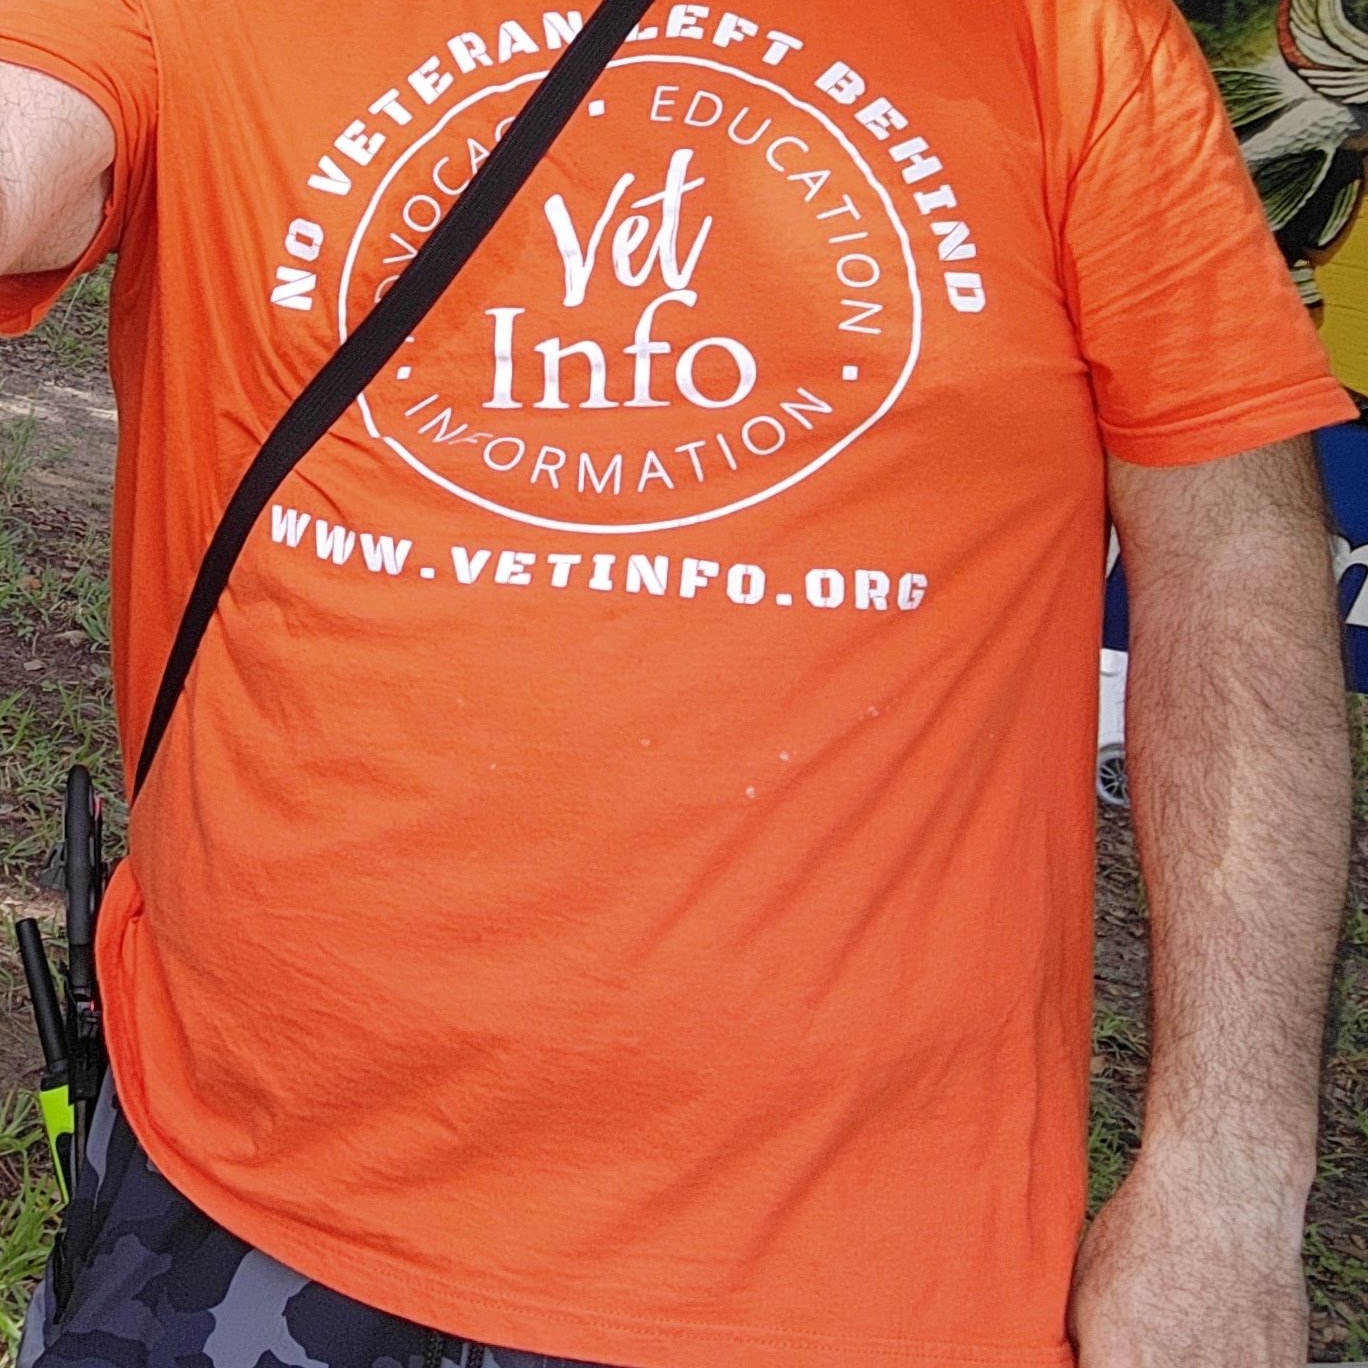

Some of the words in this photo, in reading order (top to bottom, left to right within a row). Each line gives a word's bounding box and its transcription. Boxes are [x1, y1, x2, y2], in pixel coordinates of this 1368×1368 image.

[271, 218, 324, 311] NO
[307, 11, 584, 196] VETERAN
[815, 61, 986, 312] BEHIND
[543, 148, 713, 307] Vet
[650, 85, 883, 335] EDUCATION
[482, 291, 757, 410] Info
[405, 387, 834, 496] INFORMATION
[271, 504, 928, 611] WWW.VETINFO.ORG
